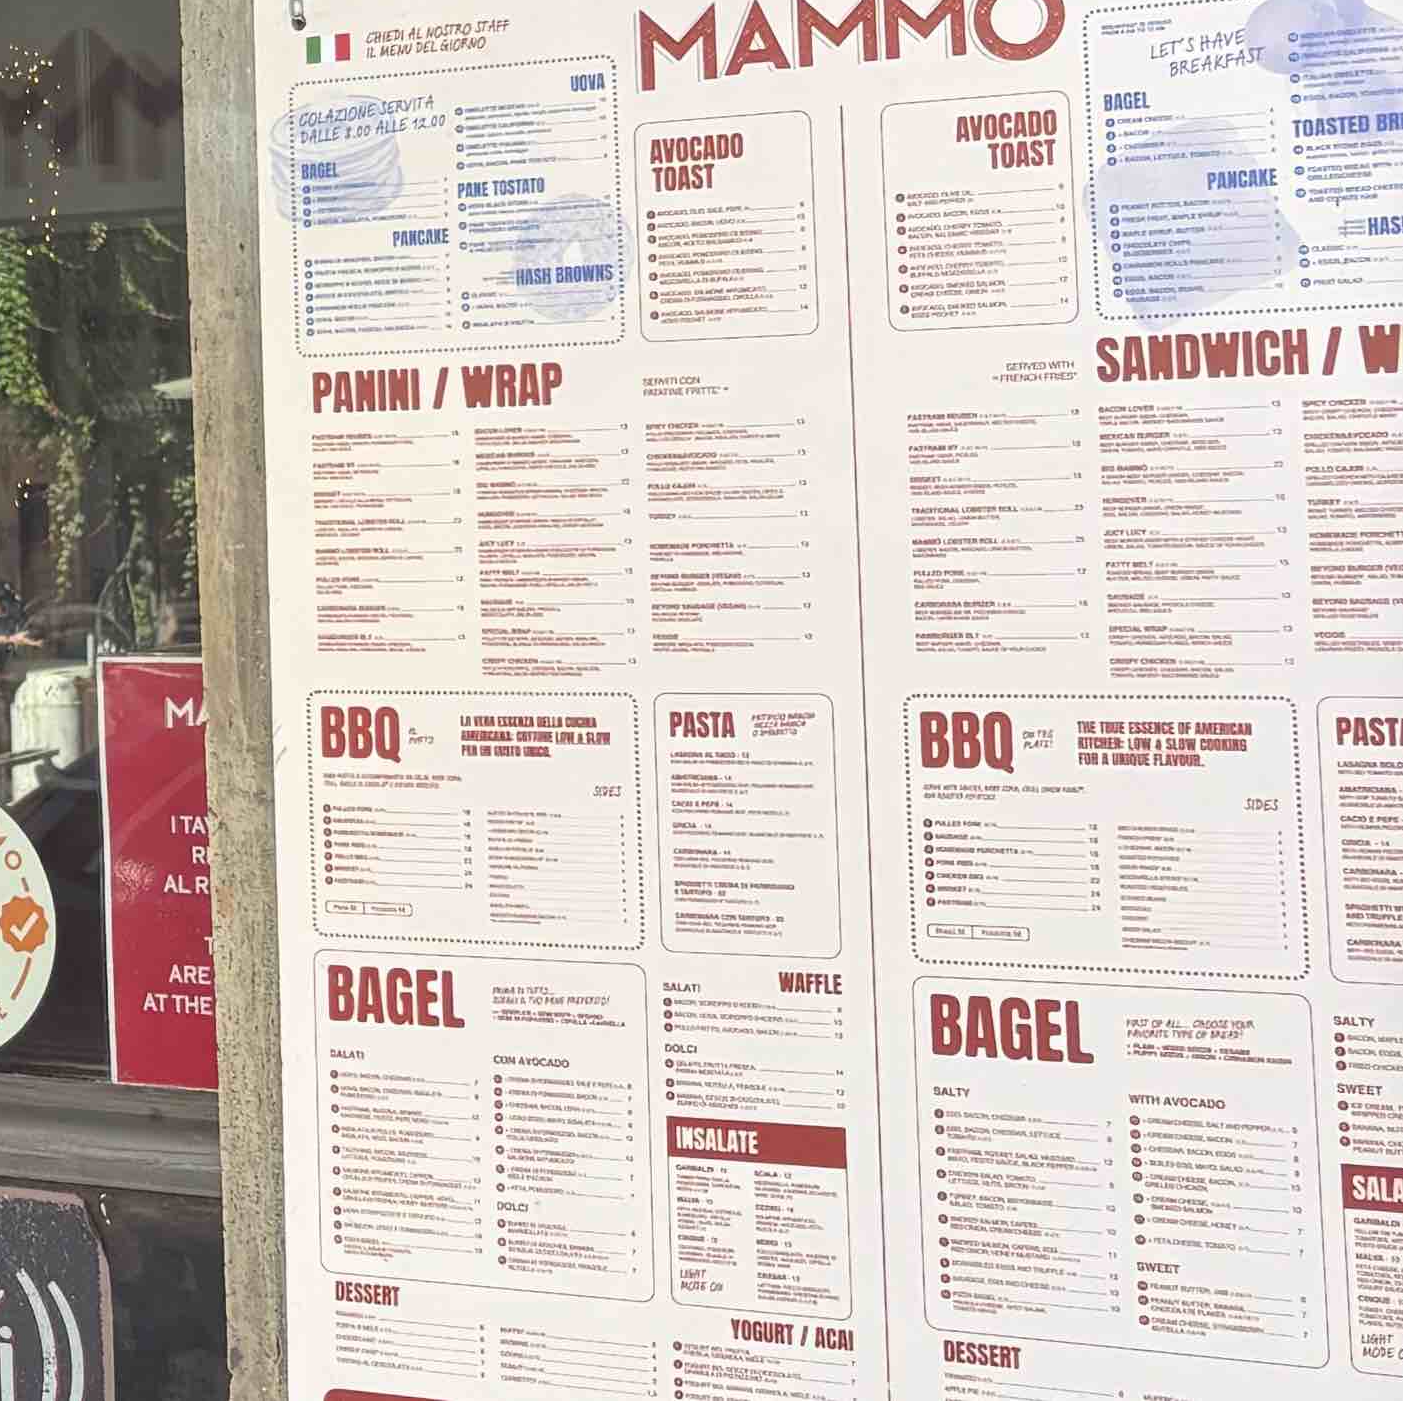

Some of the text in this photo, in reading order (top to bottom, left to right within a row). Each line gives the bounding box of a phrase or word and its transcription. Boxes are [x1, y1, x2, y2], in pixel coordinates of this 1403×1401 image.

[366, 20, 510, 44] CHIEDI AL NOSTRO STAFF
[366, 36, 487, 59] IL MENU DEL GIORNO
[1150, 28, 1246, 59] LET'S HAVE
[1169, 46, 1267, 78] BREAKFAST
[570, 73, 605, 92] UOVA
[1103, 91, 1151, 112] BAGEL
[299, 103, 381, 127] COLAZIONE
[956, 109, 1058, 143] AVOCADO
[1292, 112, 1403, 138] TOASTED BR
[300, 127, 340, 144] DALLE
[375, 118, 407, 134] ALLE
[412, 115, 446, 131] 12.00
[650, 132, 744, 164] AVOCADO
[988, 139, 1056, 169] TOAST
[301, 162, 340, 180] BAGEL
[652, 164, 715, 192] TOAST
[1207, 168, 1279, 190] PANCAKE
[457, 181, 488, 198] PANE
[493, 177, 545, 196] TOSTATO
[393, 229, 450, 247] PANCAKE
[515, 264, 614, 287] HASH BROWNS
[1048, 360, 1075, 370] WITH
[1096, 328, 1310, 383] SANDWICH
[312, 362, 563, 413] PANINI WRAP
[321, 706, 402, 764] BBQ
[669, 711, 735, 738] PASTA
[1077, 722, 1252, 737] THE TRUE ESSENCE OF AMERICAN
[1336, 717, 1403, 746] PAST
[920, 710, 1014, 774] BBQ
[1128, 739, 1152, 751] LOW
[1165, 739, 1196, 752] SLOW
[1200, 739, 1248, 752] COOKING
[1078, 753, 1205, 767] FOR A UNIQUE FLAVOUR.
[1243, 798, 1279, 812] SIDES
[163, 874, 192, 894] AL
[169, 964, 211, 984] ARE
[778, 971, 843, 995] WAFFLE
[328, 964, 466, 1029] BAGEL
[663, 982, 701, 993] SALATI
[144, 993, 213, 1015] AT THE
[930, 993, 1095, 1065] BAGEL
[1333, 1015, 1376, 1028] SALTY
[664, 1043, 697, 1054] DOLCI
[518, 1056, 570, 1069] AVOCADO
[933, 1085, 970, 1098] SALTY
[1337, 1083, 1383, 1096] SWEET
[1129, 1094, 1226, 1109] WITH AVOCADO
[676, 1125, 759, 1154] INSALATE
[496, 1201, 529, 1213] DOLCI
[1137, 1262, 1180, 1273] SWEET
[335, 1281, 401, 1307] DESSERT
[731, 1318, 854, 1351] YOGURT ACAI
[1361, 1334, 1394, 1344] LIGHT
[943, 1339, 1021, 1370] DESSERT
[1362, 1347, 1394, 1358] MODE
